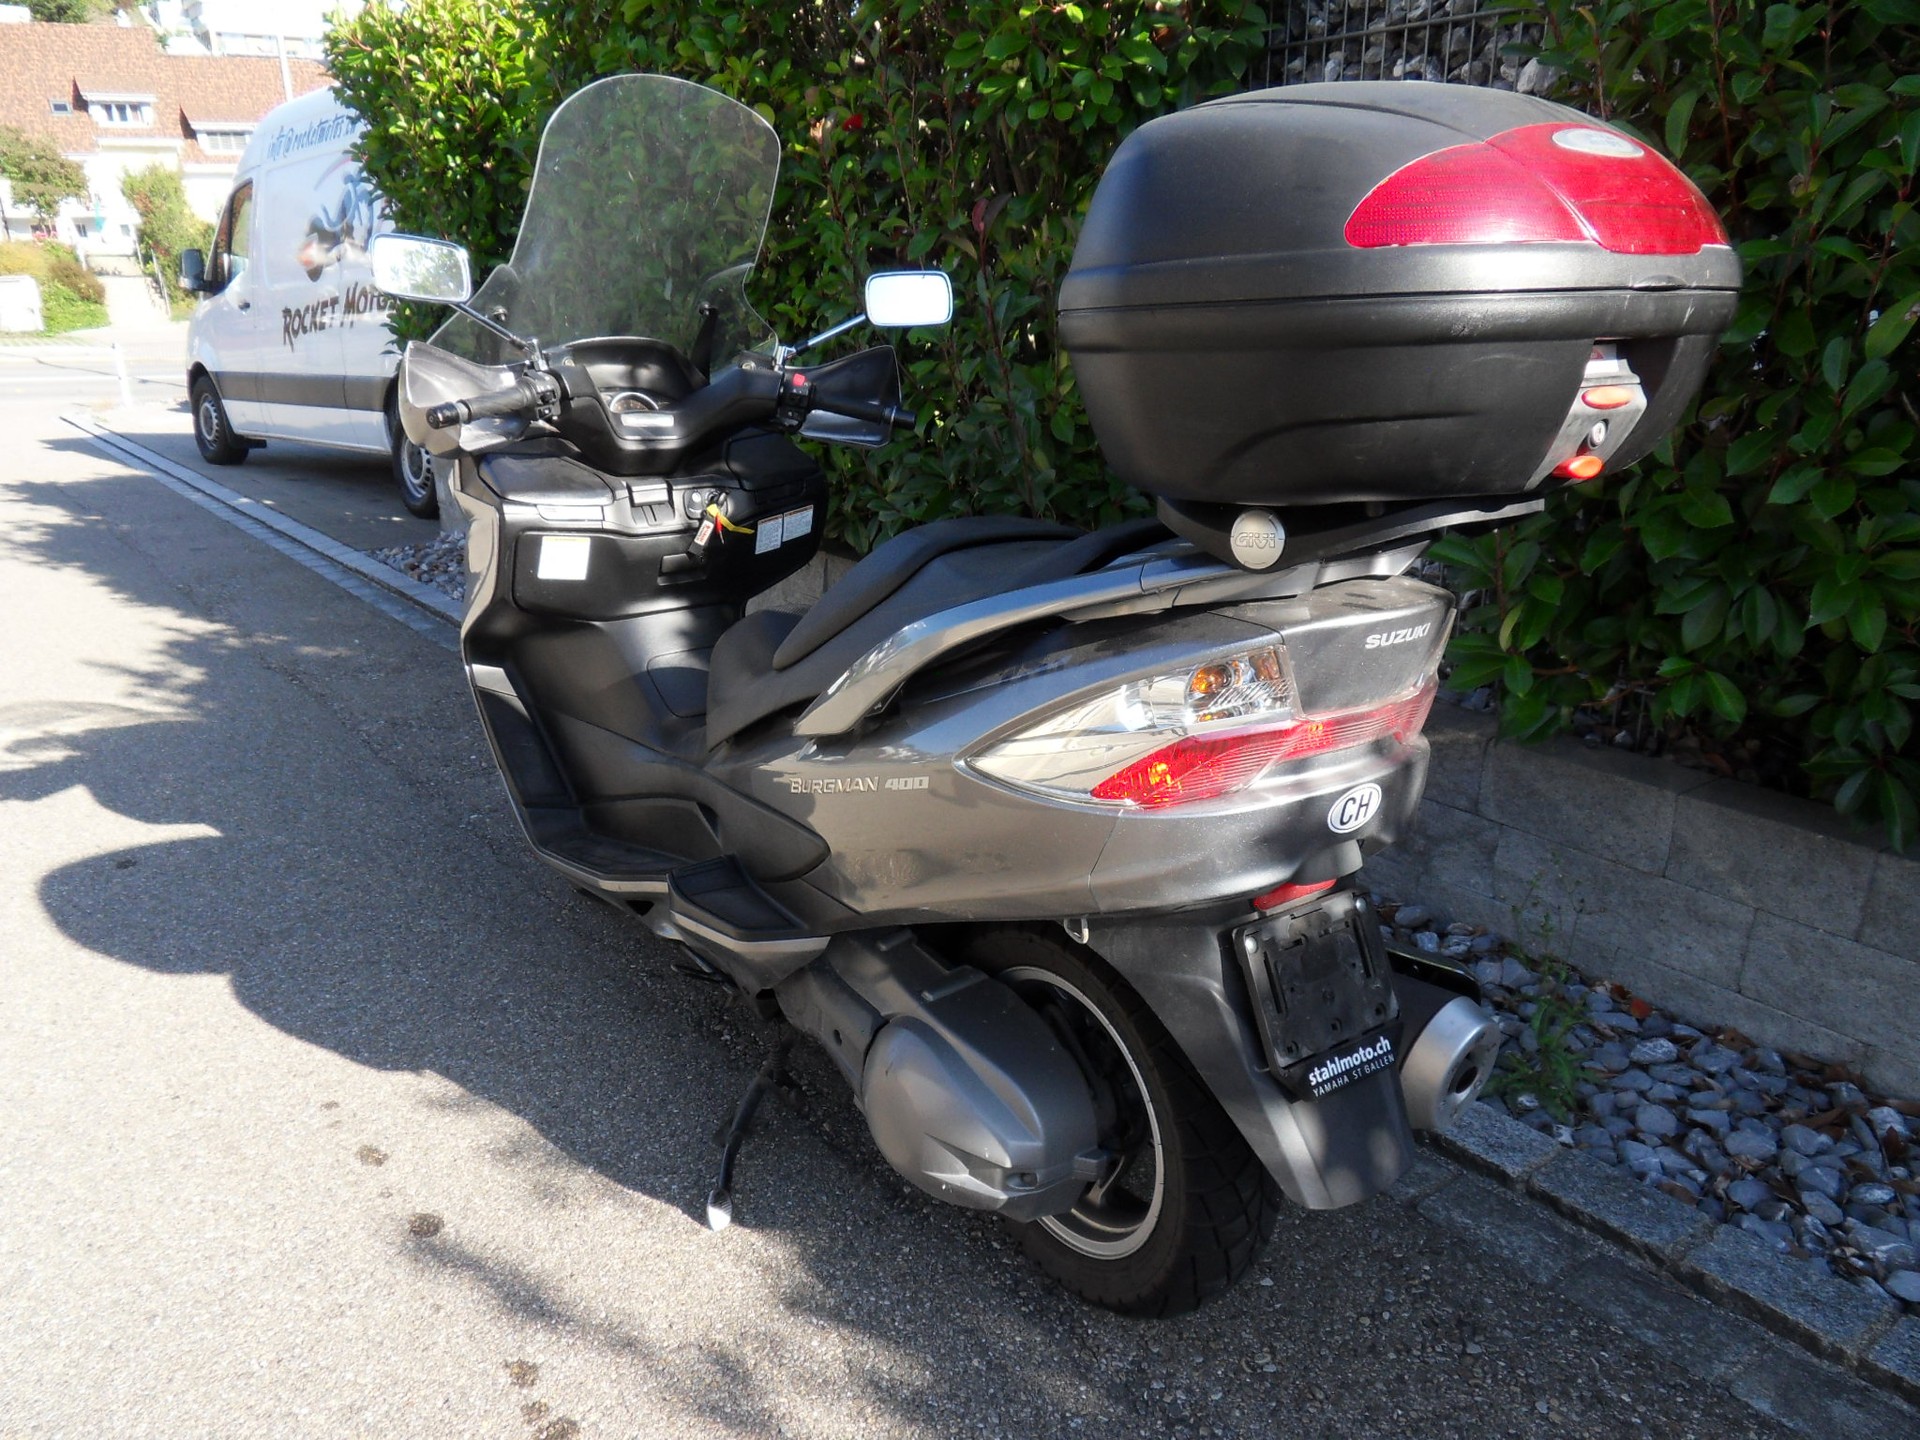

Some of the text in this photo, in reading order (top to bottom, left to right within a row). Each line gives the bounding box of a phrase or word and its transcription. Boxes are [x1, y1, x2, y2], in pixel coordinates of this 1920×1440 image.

[282, 281, 389, 352] ROCKET MOTO
[1364, 622, 1431, 649] SUZUKI
[789, 776, 930, 794] BURGMAN 400
[1340, 791, 1373, 826] CH
[1309, 1036, 1392, 1086] stahlmoto.ch
[1312, 1053, 1395, 1098] YAMAHA ST GALLEN
